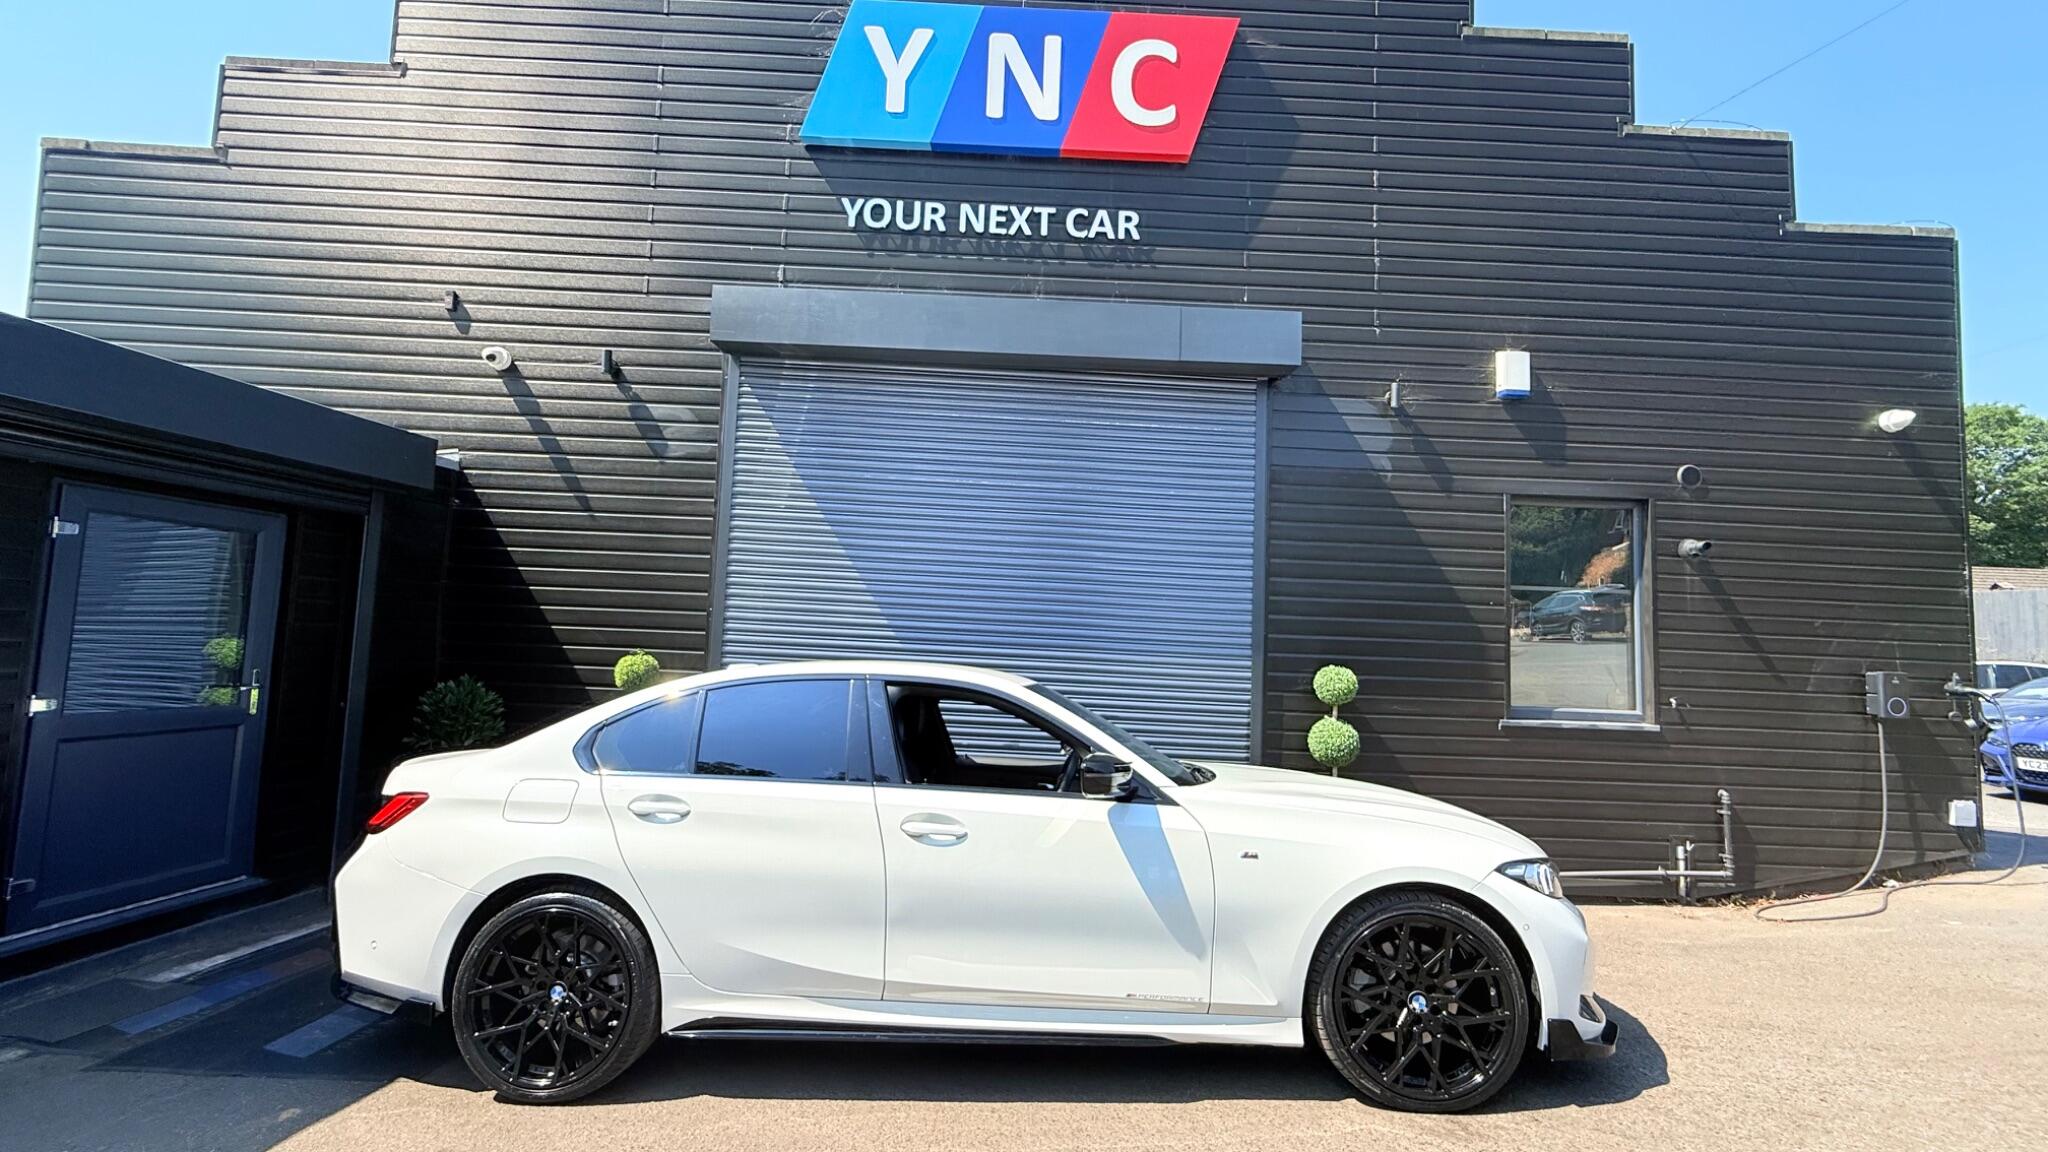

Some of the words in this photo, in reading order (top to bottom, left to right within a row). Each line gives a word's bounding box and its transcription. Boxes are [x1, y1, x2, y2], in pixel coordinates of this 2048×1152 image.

[863, 25, 1178, 127] YNC
[841, 197, 946, 232] YOUR
[959, 203, 1056, 237] NEXT
[1066, 207, 1141, 241] CAR
